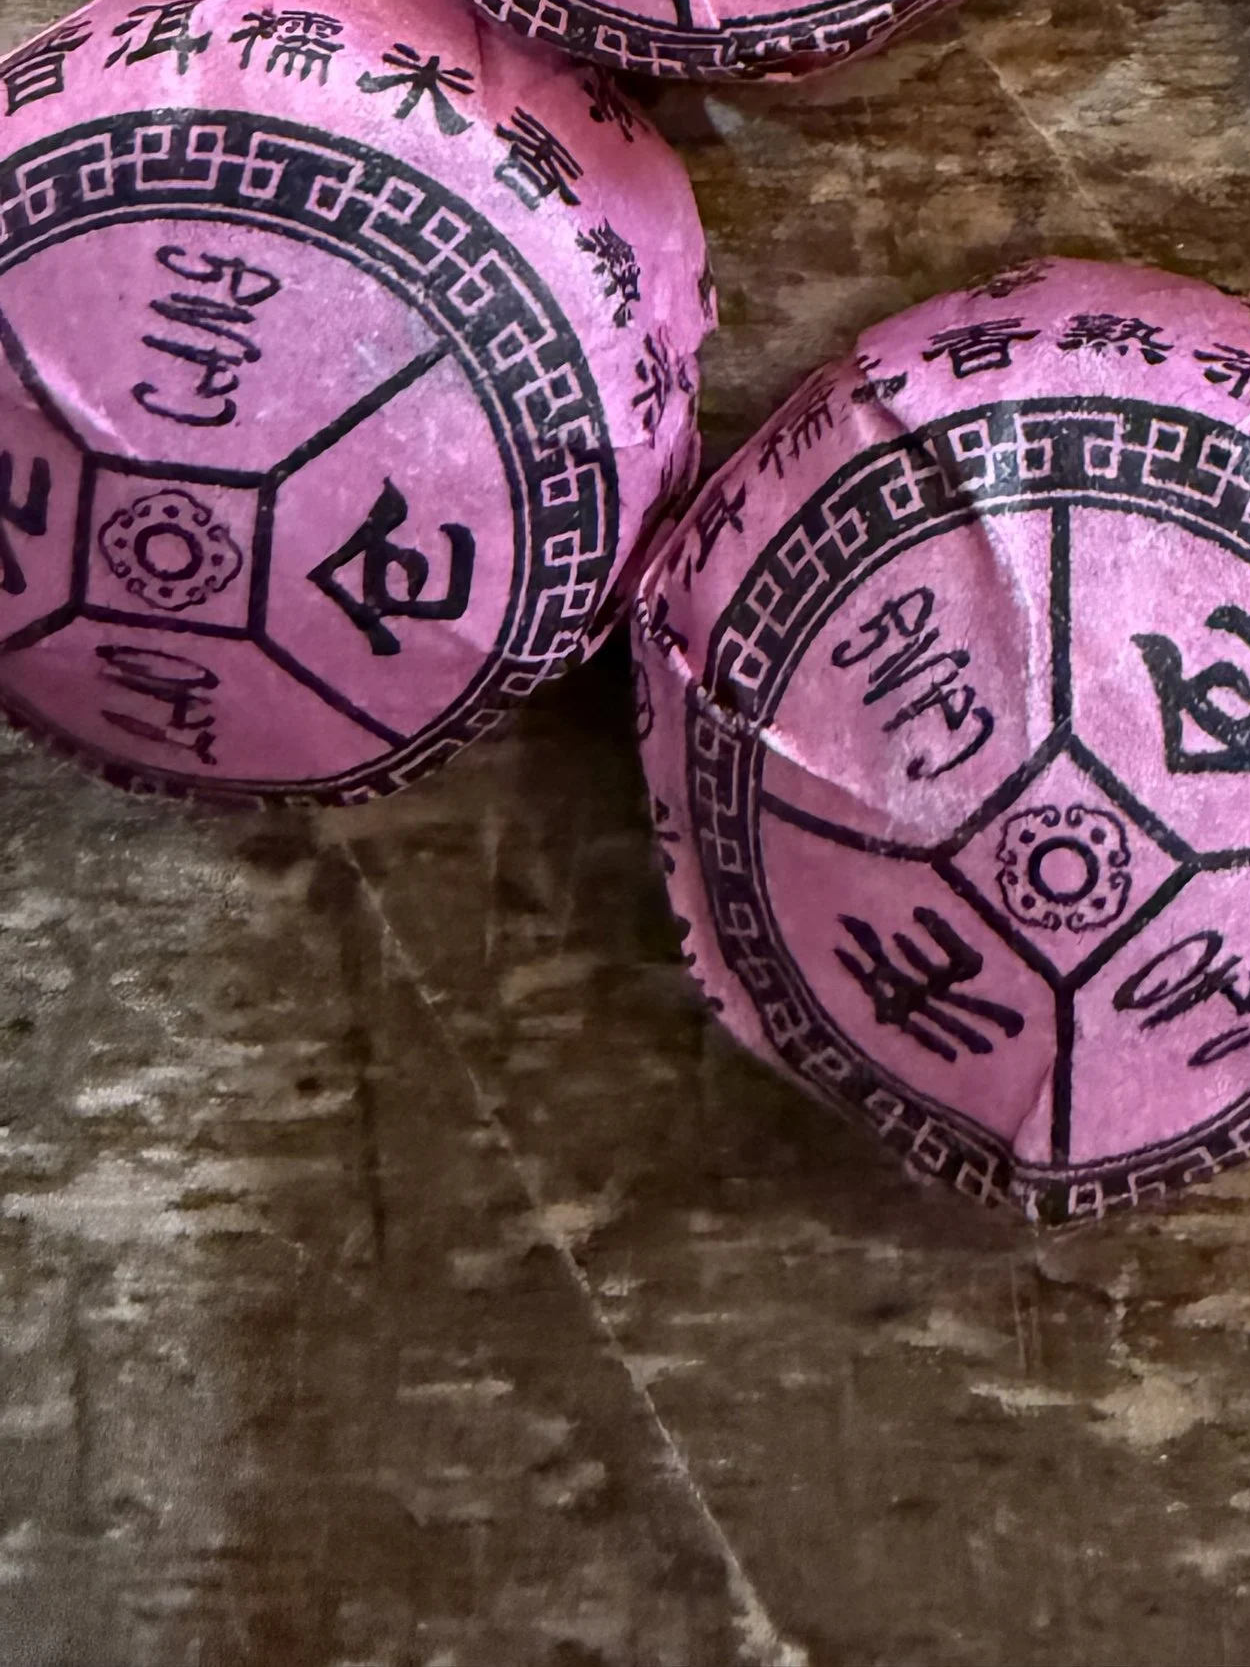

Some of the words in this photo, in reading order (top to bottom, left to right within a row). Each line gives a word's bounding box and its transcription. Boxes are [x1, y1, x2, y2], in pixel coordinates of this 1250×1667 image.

[131, 243, 281, 427] CANG
[307, 478, 476, 656] 仓
[93, 644, 220, 766] LAO
[830, 585, 996, 783] CANG
[833, 904, 1026, 1064] 老
